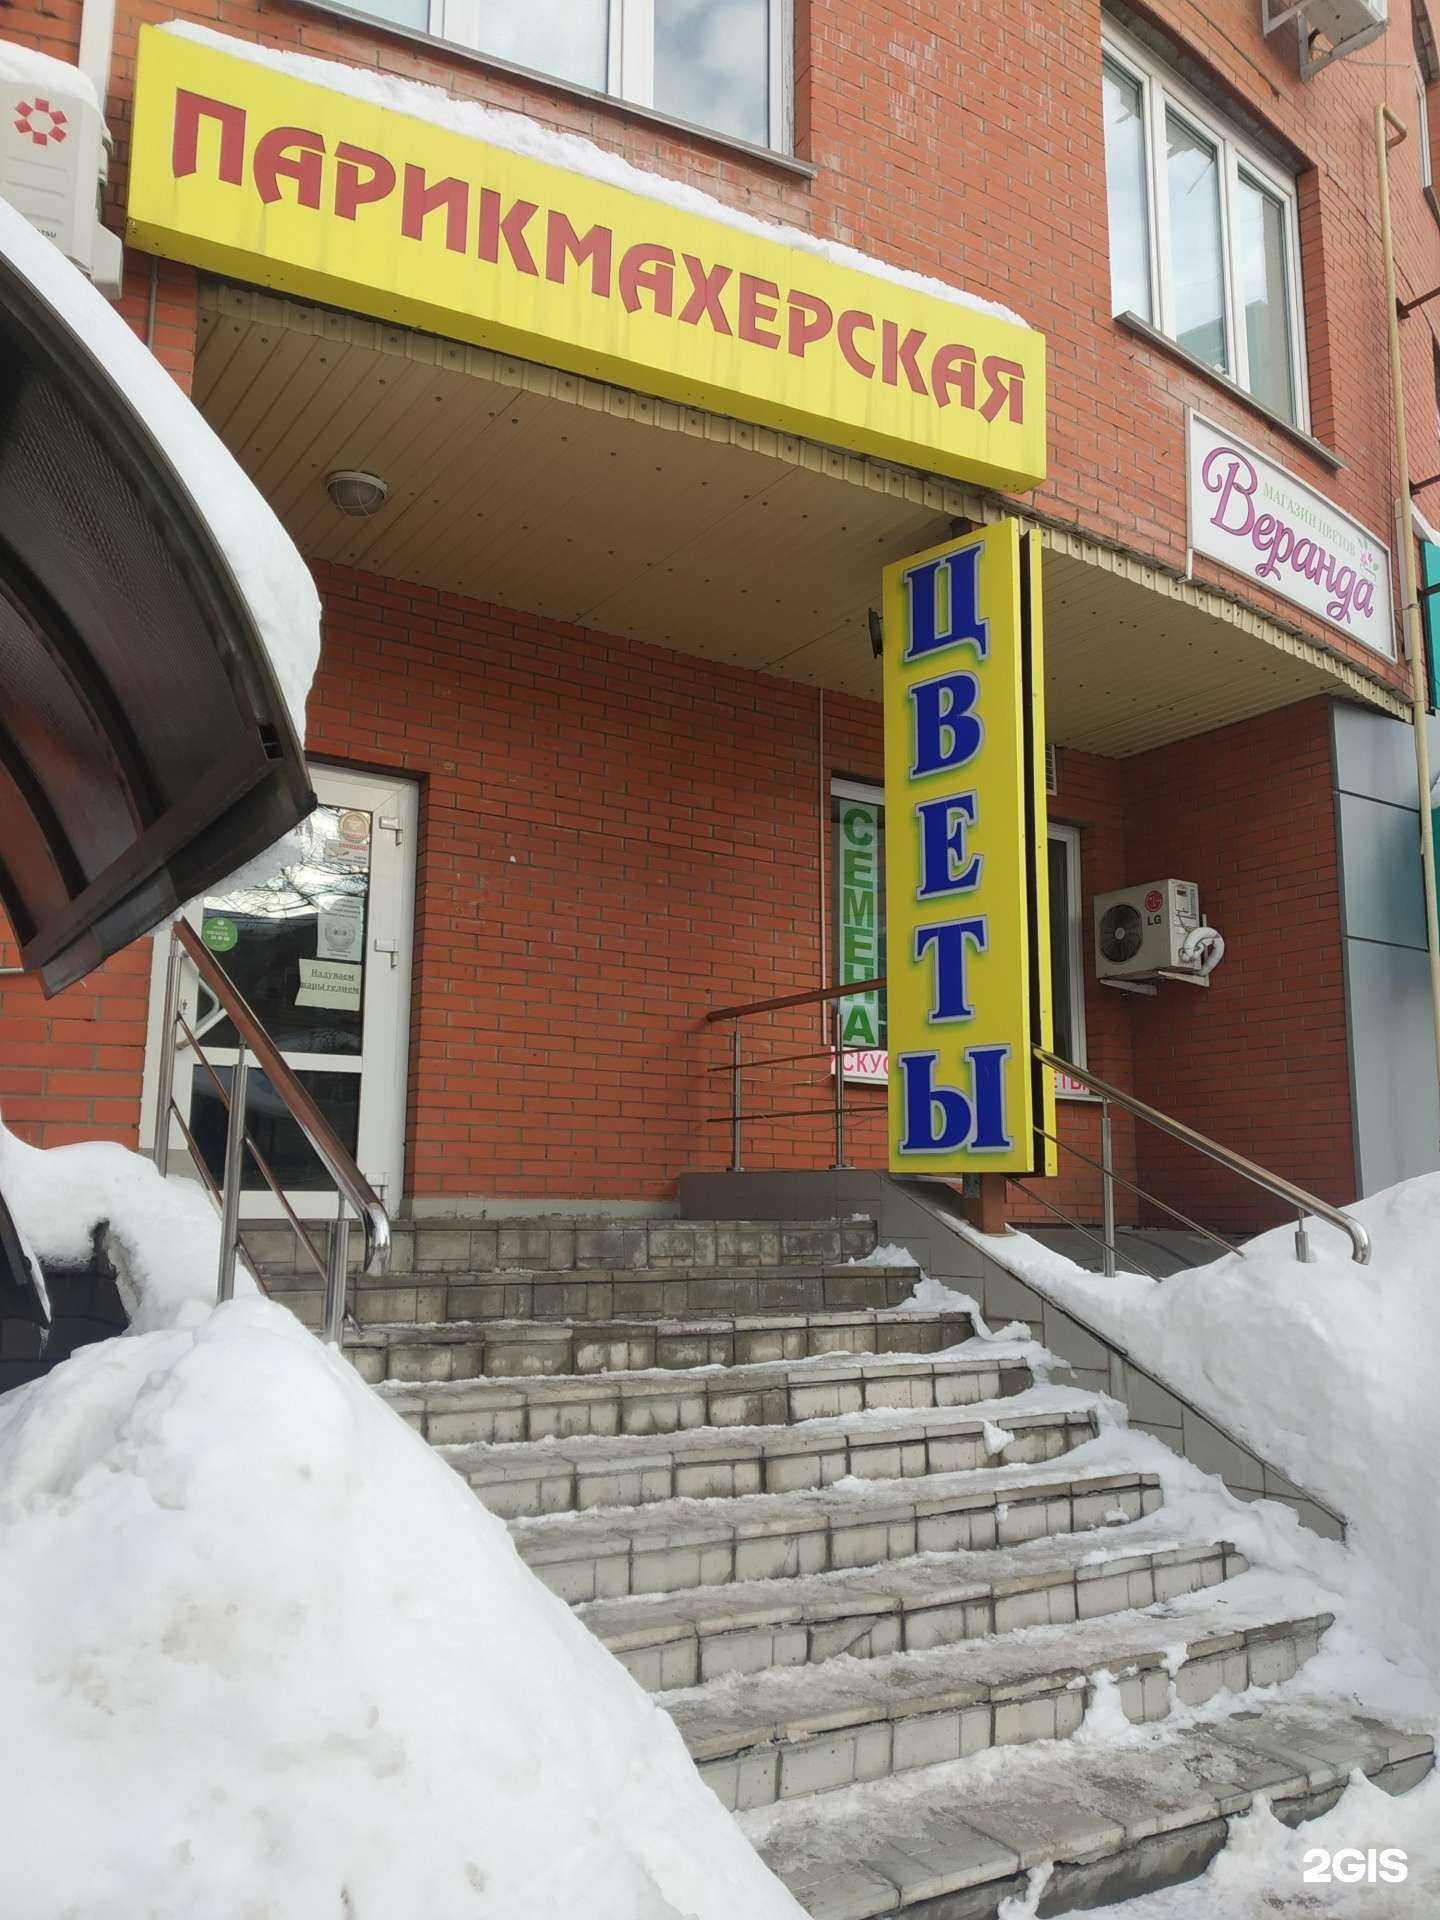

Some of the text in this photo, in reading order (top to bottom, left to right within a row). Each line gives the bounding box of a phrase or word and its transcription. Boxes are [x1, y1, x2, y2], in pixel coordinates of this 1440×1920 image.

[172, 88, 1025, 425] ПАРИКМАХЕРСКАЯ
[1202, 447, 1374, 624] Веранда
[1263, 482, 1357, 557] МАГАЗИН ЦВЕТОВ
[842, 808, 876, 1044] СЕМЕНА
[898, 540, 1014, 1155] ЦВЕТЫ
[1147, 914, 1162, 926] LG
